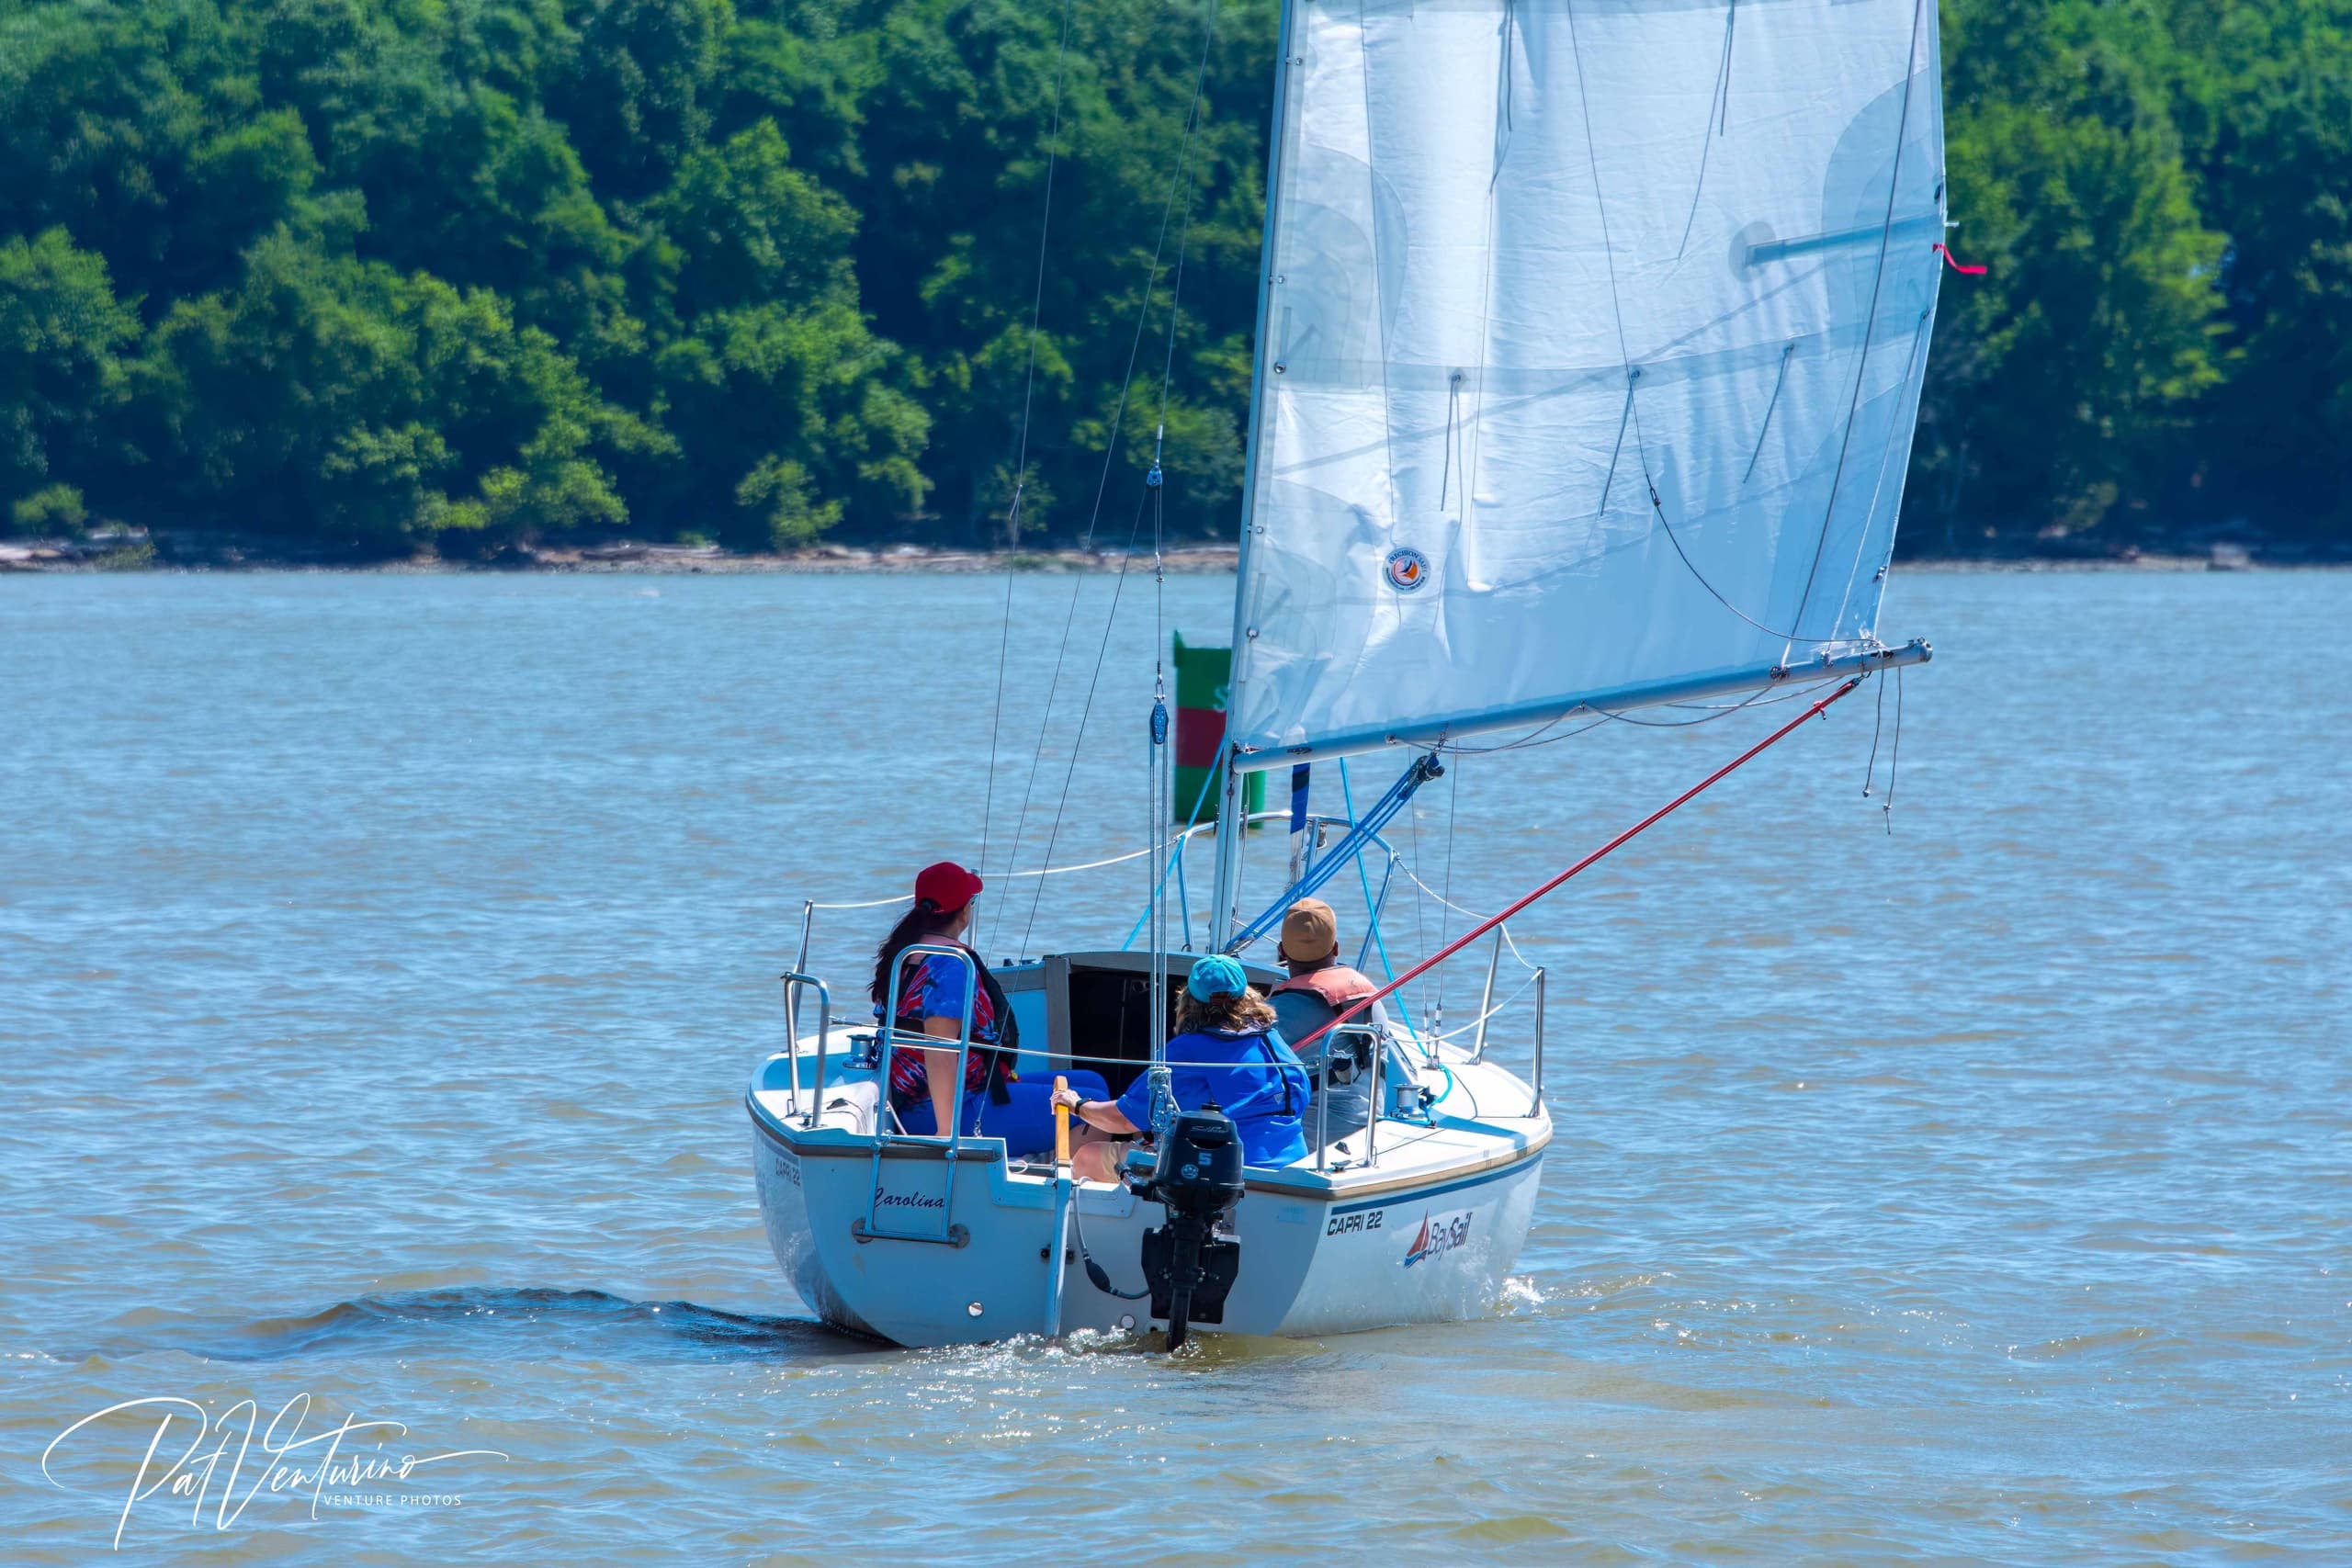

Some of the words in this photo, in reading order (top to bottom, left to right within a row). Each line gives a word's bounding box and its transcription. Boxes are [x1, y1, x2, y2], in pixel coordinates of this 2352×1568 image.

[1198, 1152, 1213, 1166] 5
[875, 1186, 945, 1208] Carolina
[1327, 1213, 1364, 1236] CAPRI
[1366, 1211, 1383, 1230] 22
